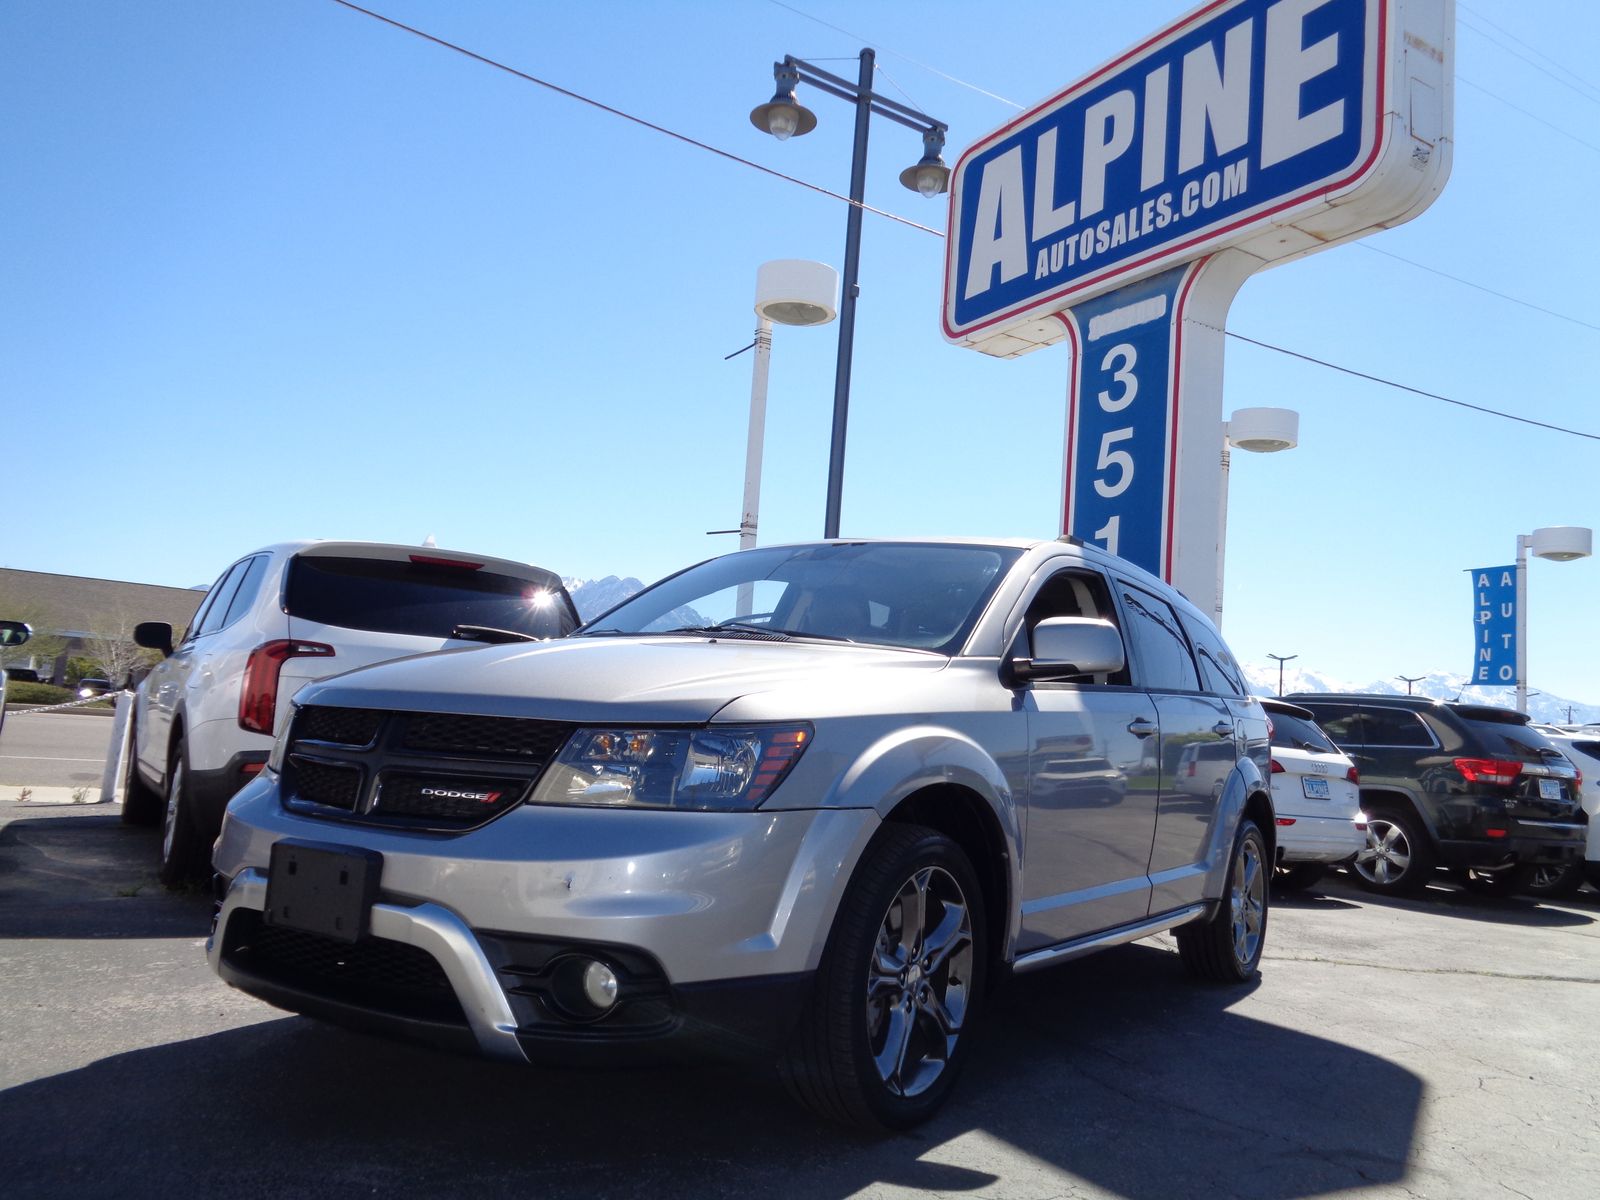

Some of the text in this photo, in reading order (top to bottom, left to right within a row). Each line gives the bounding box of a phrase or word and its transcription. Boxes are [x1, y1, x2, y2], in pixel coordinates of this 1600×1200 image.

[964, 0, 1345, 301] ALPINE
[1034, 157, 1249, 281] AUTOSALES.COM
[1477, 573, 1492, 681] ALPINE
[1499, 571, 1513, 681] AUTO
[421, 788, 489, 801] DODGE
